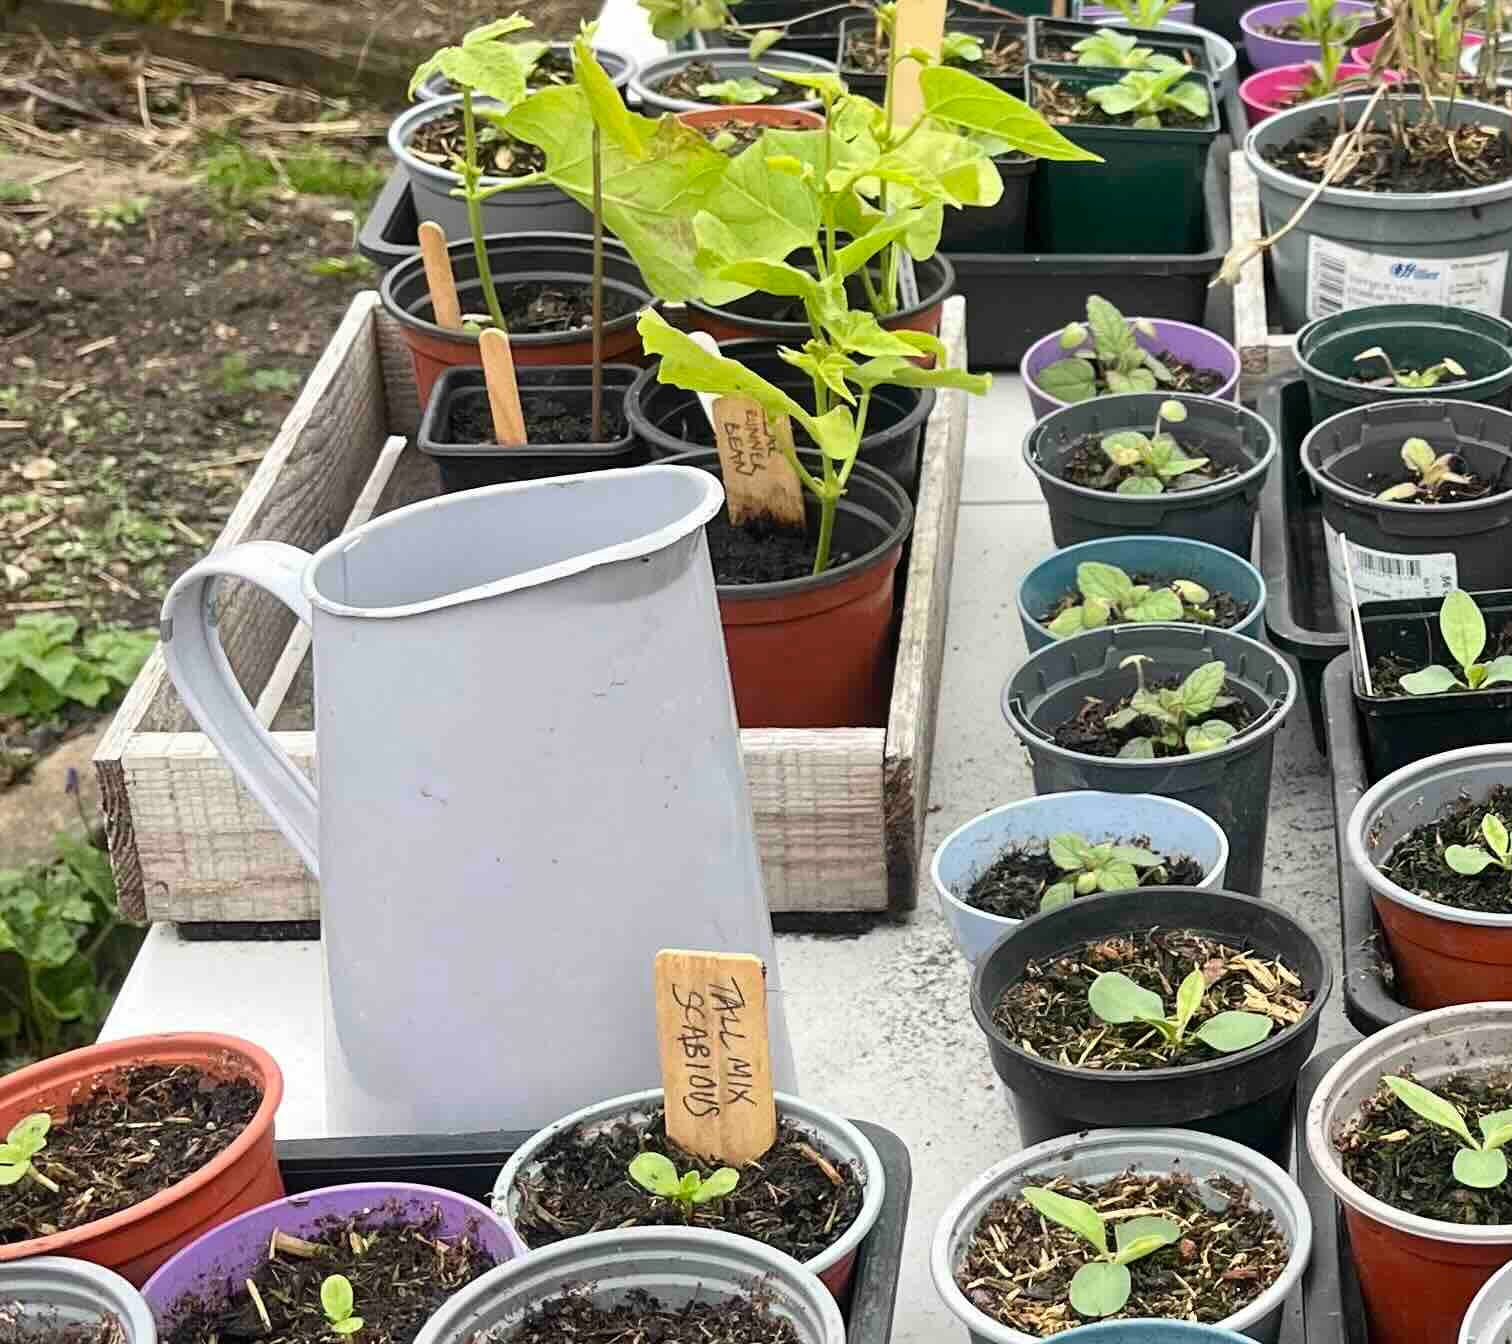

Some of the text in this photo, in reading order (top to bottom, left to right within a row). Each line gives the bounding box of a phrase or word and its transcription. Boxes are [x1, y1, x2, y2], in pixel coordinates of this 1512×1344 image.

[724, 423, 755, 477] BEAN
[671, 983, 720, 1118] SCABIOUS
[708, 975, 757, 1108] TALL MIX
